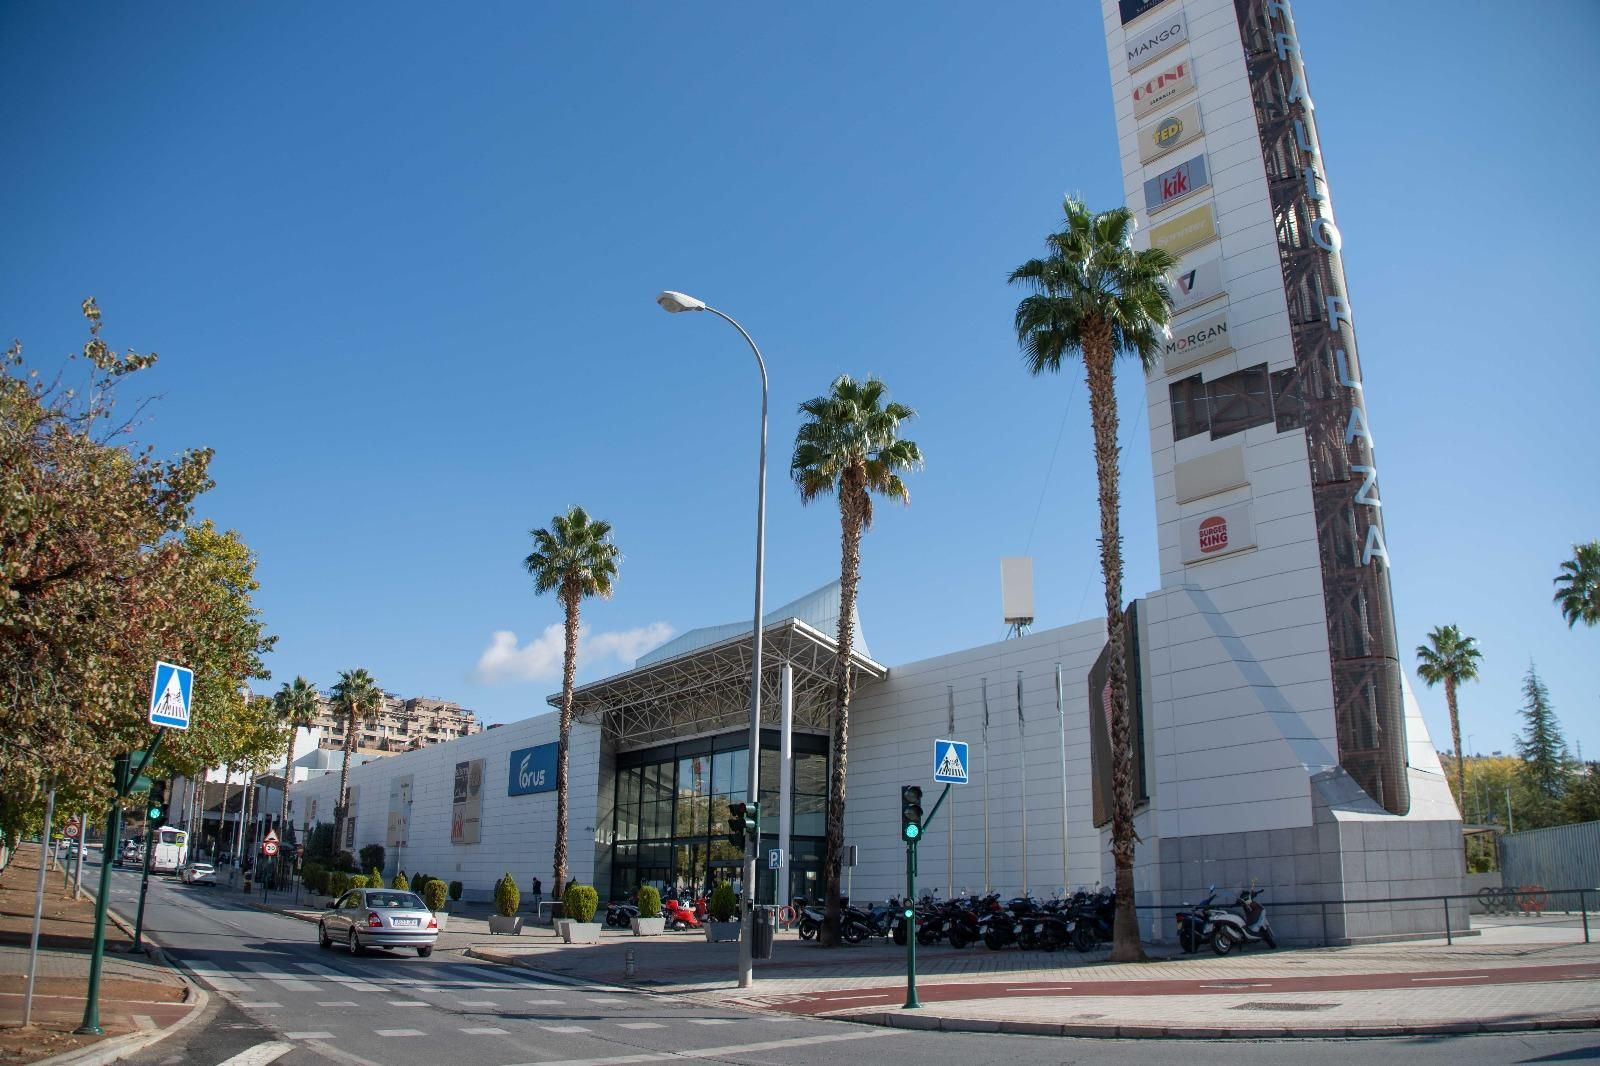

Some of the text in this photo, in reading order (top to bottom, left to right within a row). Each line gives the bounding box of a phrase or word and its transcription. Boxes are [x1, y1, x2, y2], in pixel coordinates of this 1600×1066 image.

[1127, 24, 1181, 61] MANGO
[1166, 321, 1228, 355] MORGAN
[1327, 296, 1390, 568] PLAZA
[1199, 524, 1227, 538] BURGER
[1199, 532, 1228, 548] KING
[770, 851, 778, 867] P
